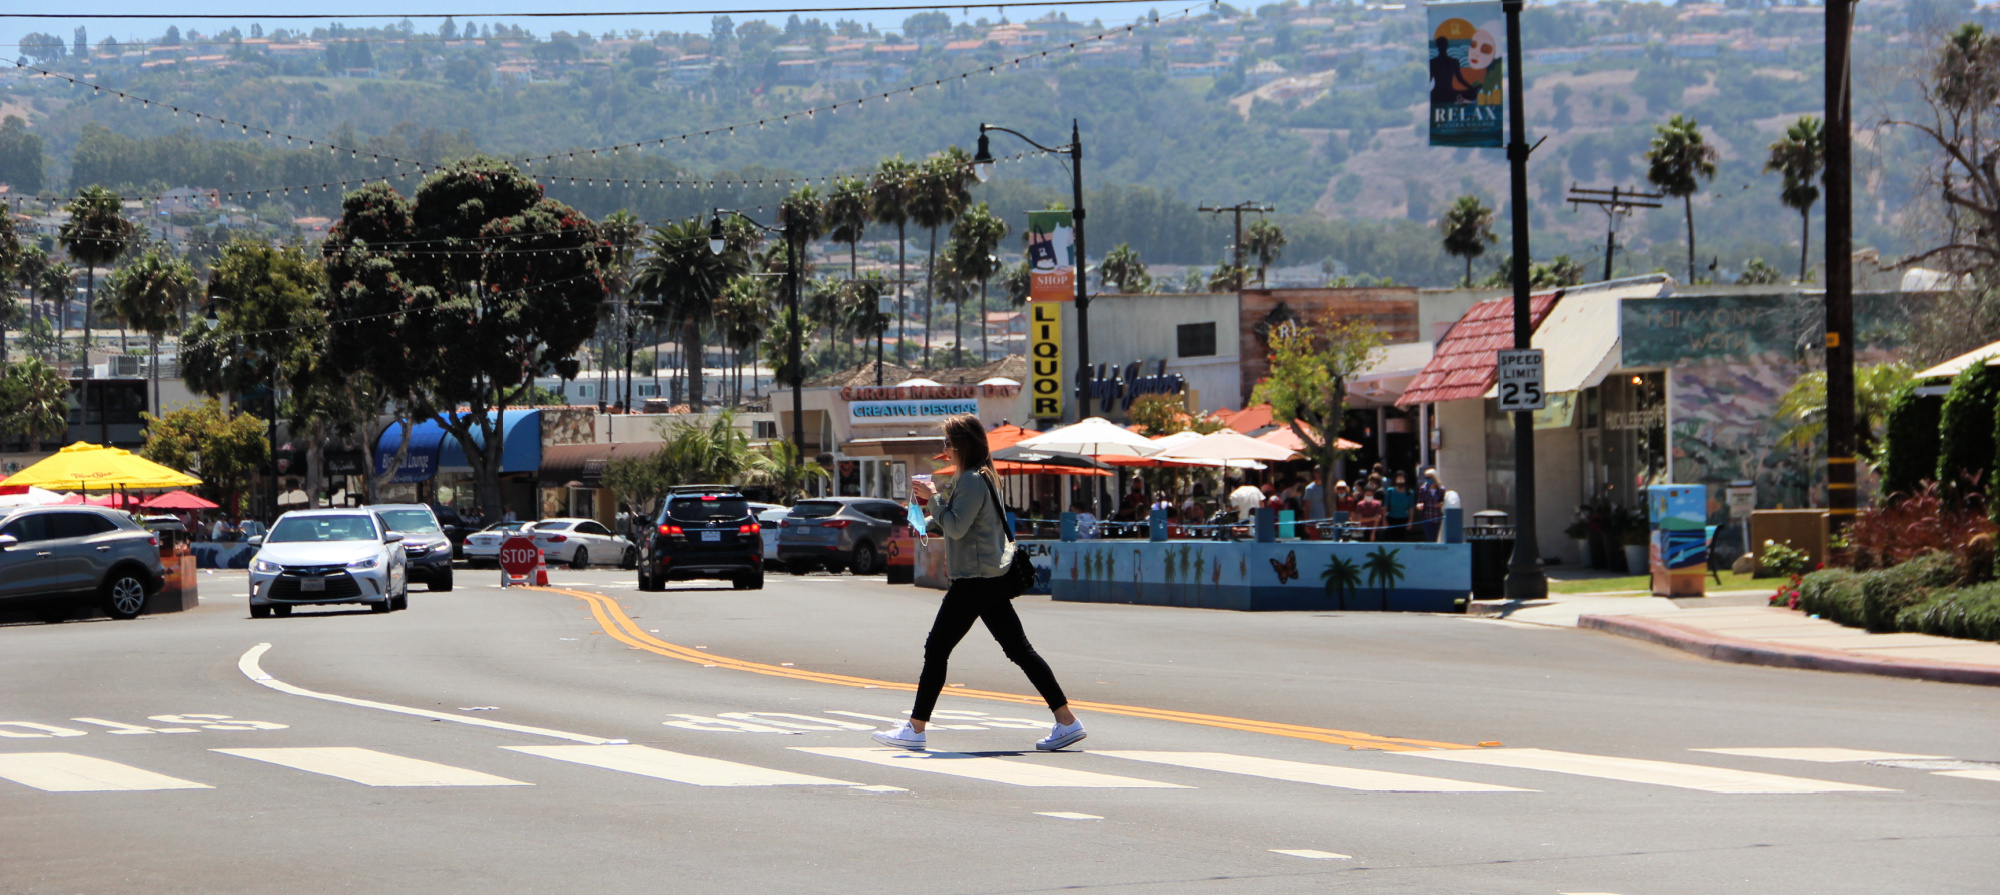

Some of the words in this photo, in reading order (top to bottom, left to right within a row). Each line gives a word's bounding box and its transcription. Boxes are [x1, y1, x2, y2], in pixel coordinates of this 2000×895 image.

[1434, 106, 1497, 122] RELAX
[1037, 275, 1068, 285] SHOP
[1034, 306, 1059, 414] LIQUOR
[1501, 355, 1542, 366] SPEED
[1503, 369, 1537, 379] LIMIT
[841, 385, 905, 400] CAROLE
[911, 385, 978, 399] MAGGIO
[1502, 382, 1541, 405] 25
[854, 403, 918, 417] CREATIVE
[920, 402, 979, 416] DESIGNS
[408, 454, 429, 472] Lounge
[502, 549, 536, 564] STOP
[0, 713, 290, 738] STO
